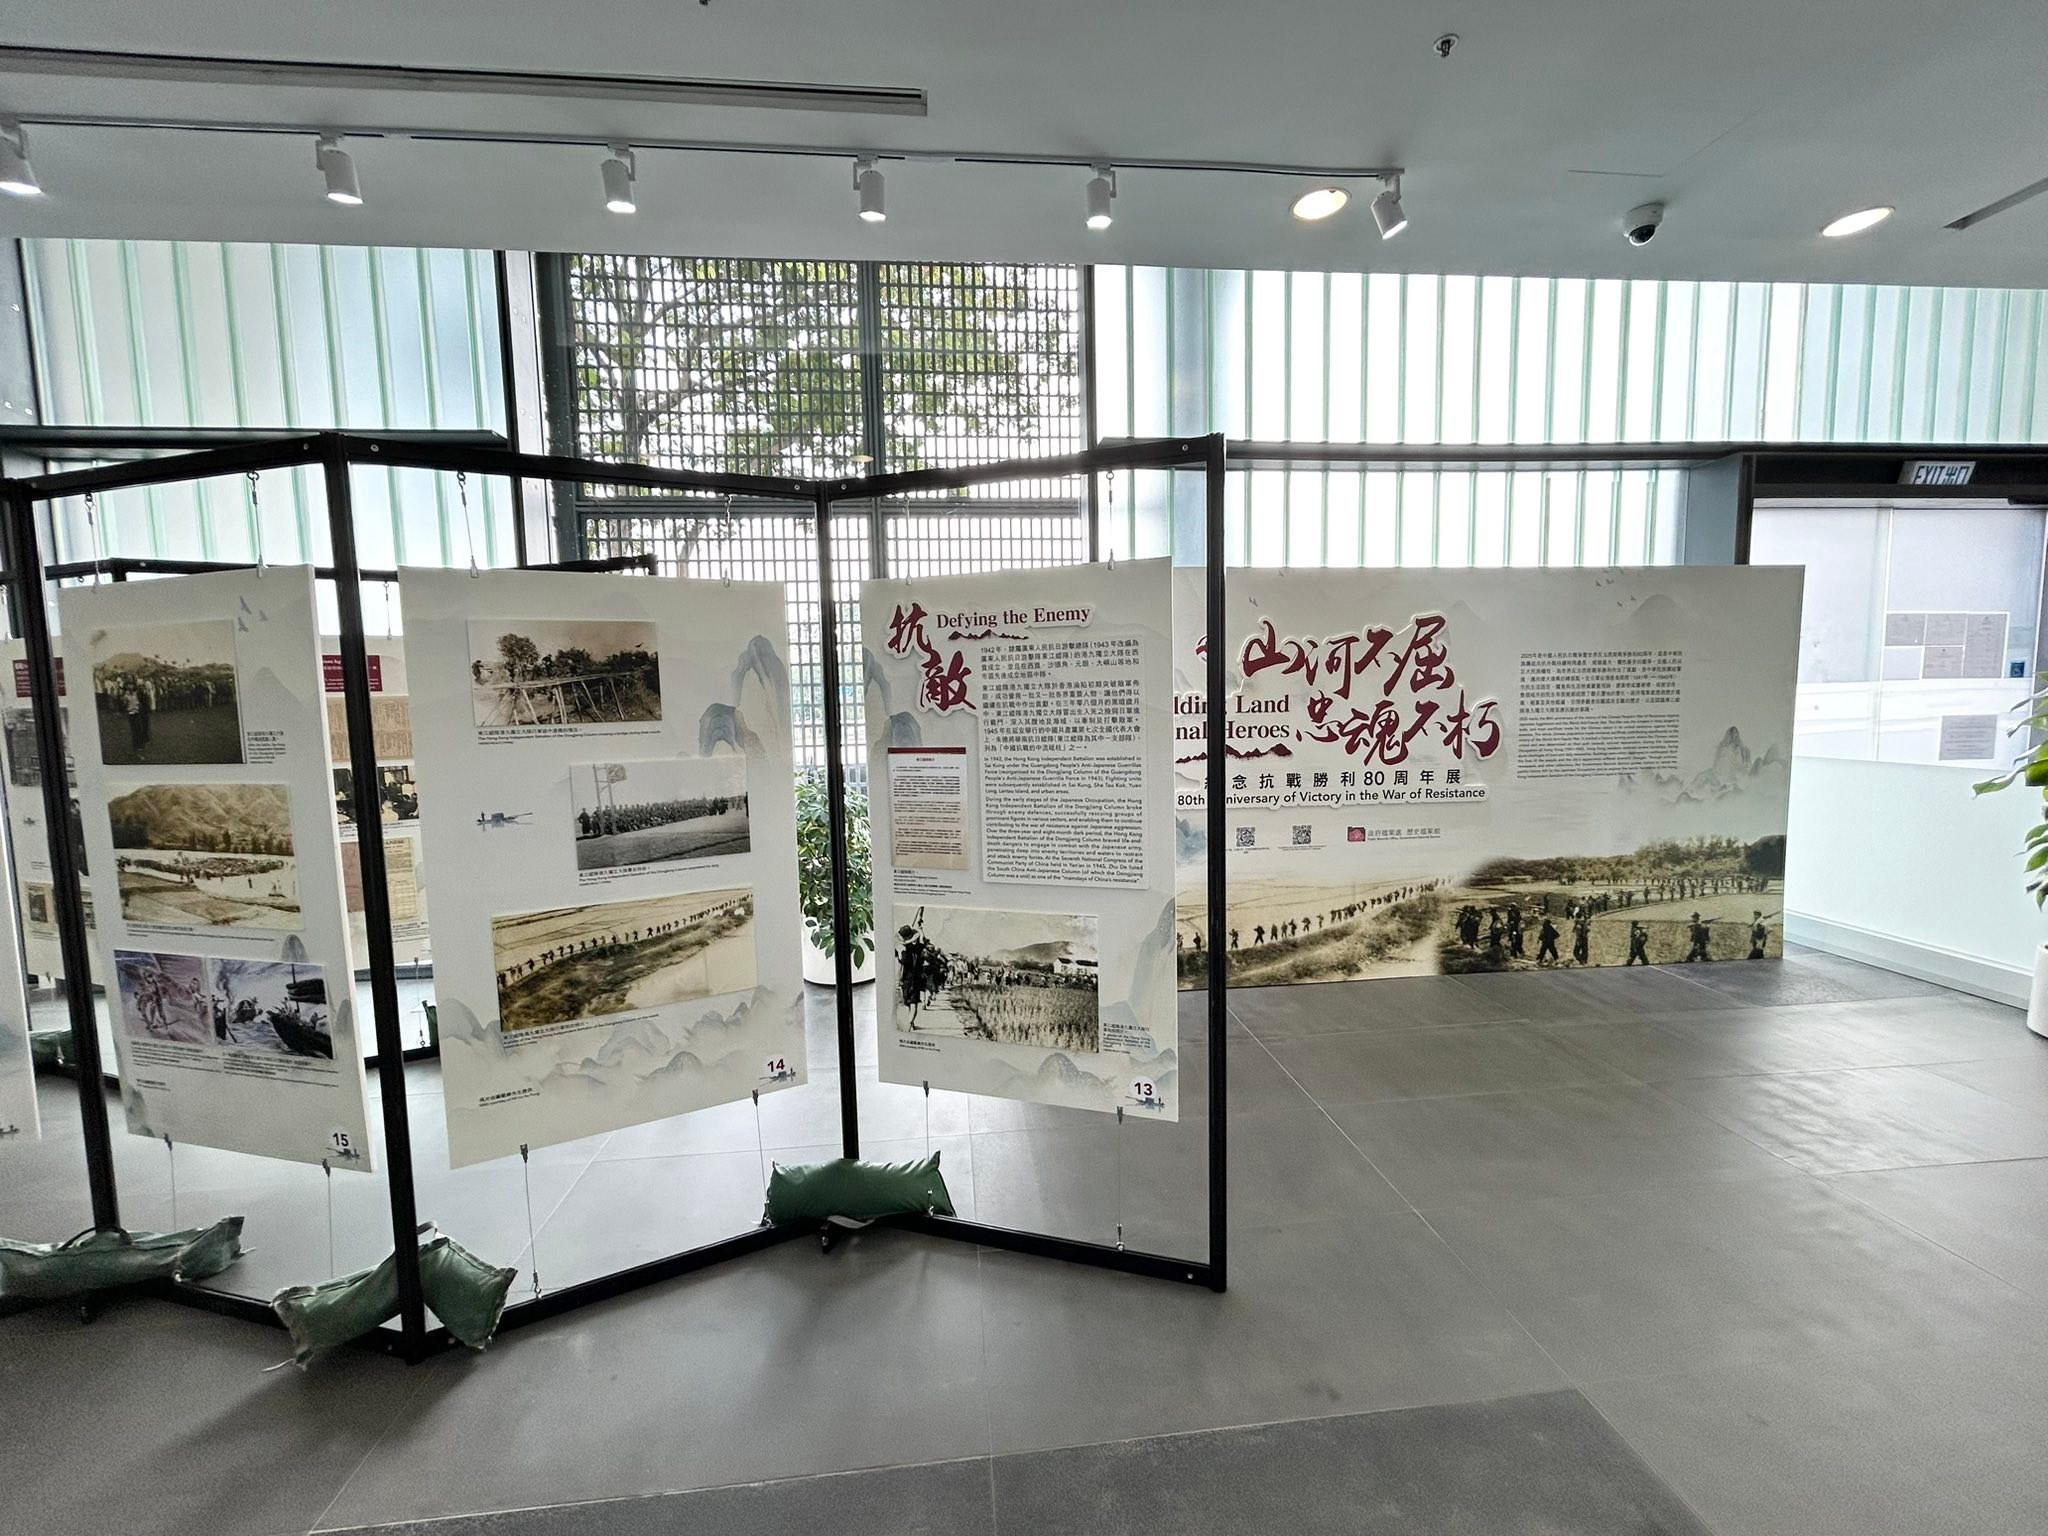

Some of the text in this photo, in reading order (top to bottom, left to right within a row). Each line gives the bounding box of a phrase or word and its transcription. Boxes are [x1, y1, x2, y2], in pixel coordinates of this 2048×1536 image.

[937, 608, 1090, 629] Defying the Enemy
[1236, 694, 1289, 714] Land
[1178, 794, 1204, 806] 80th
[1284, 791, 1296, 802] of
[1300, 789, 1341, 804] Victory
[1346, 789, 1356, 802] in
[1360, 788, 1378, 801] the
[1382, 788, 1406, 800] War
[1410, 788, 1422, 800] of
[1426, 788, 1486, 799] Resistance
[768, 1058, 786, 1073] 14
[1134, 1082, 1154, 1096] 13
[332, 1132, 350, 1148] 15
